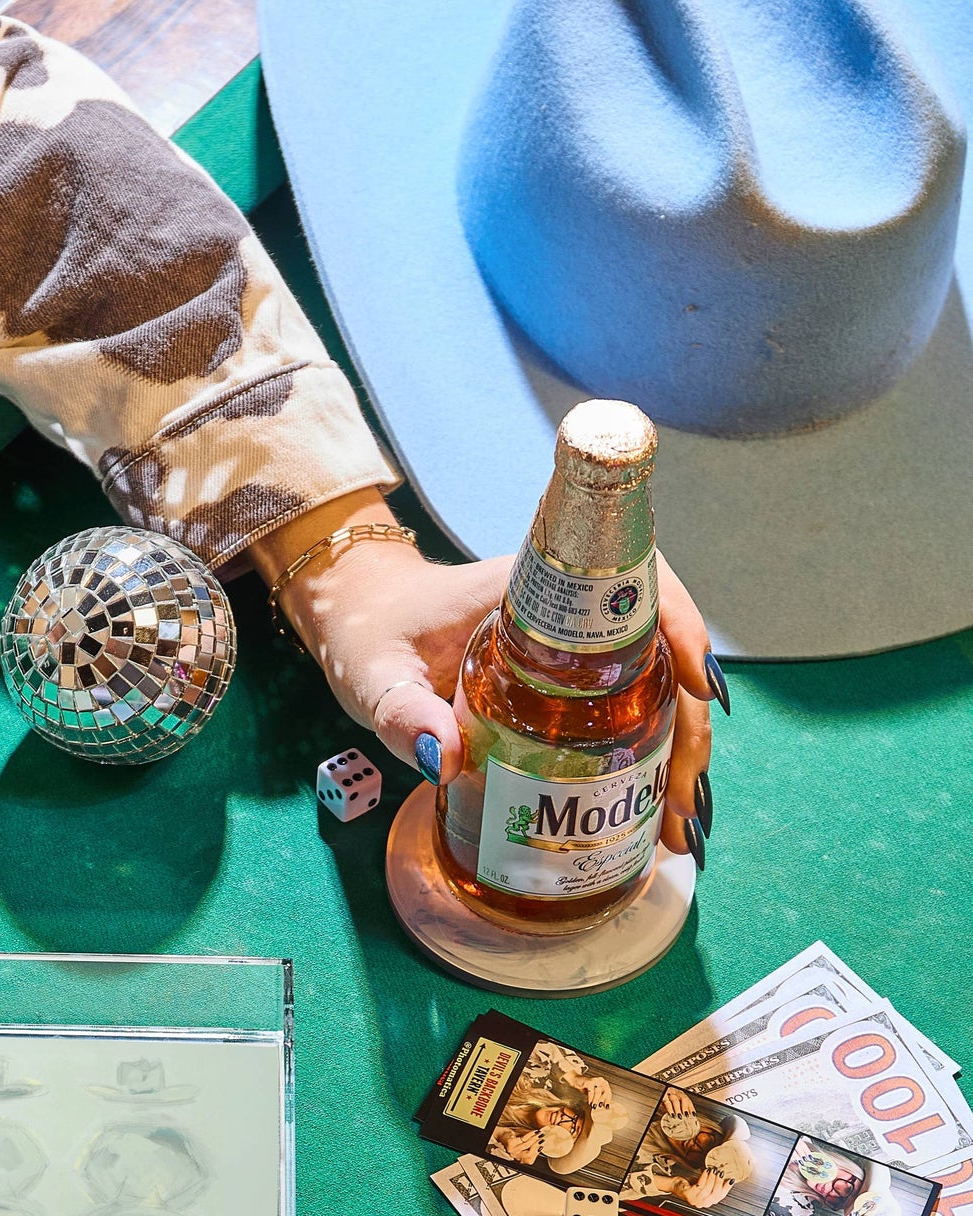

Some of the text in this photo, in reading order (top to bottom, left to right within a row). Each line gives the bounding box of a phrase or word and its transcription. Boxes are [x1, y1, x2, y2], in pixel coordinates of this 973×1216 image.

[535, 562, 594, 593] BREWED IN MEXICO
[526, 610, 557, 633] CERVECERIA
[606, 624, 629, 637] MEXICO
[534, 758, 671, 838] Modelo
[593, 770, 648, 798] CERVEZA
[605, 832, 626, 846] 1925
[483, 865, 490, 875] 12
[500, 874, 510, 885] OZ.
[438, 1041, 473, 1098] @Photomatica
[663, 1038, 731, 1080] PURPOSES
[704, 1056, 780, 1090] PURPOSES
[466, 1064, 490, 1096] TAVERN
[470, 1051, 512, 1119] DEVIL'S BACKBONE
[831, 1033, 947, 1154] 100
[726, 1087, 759, 1106] TOYS
